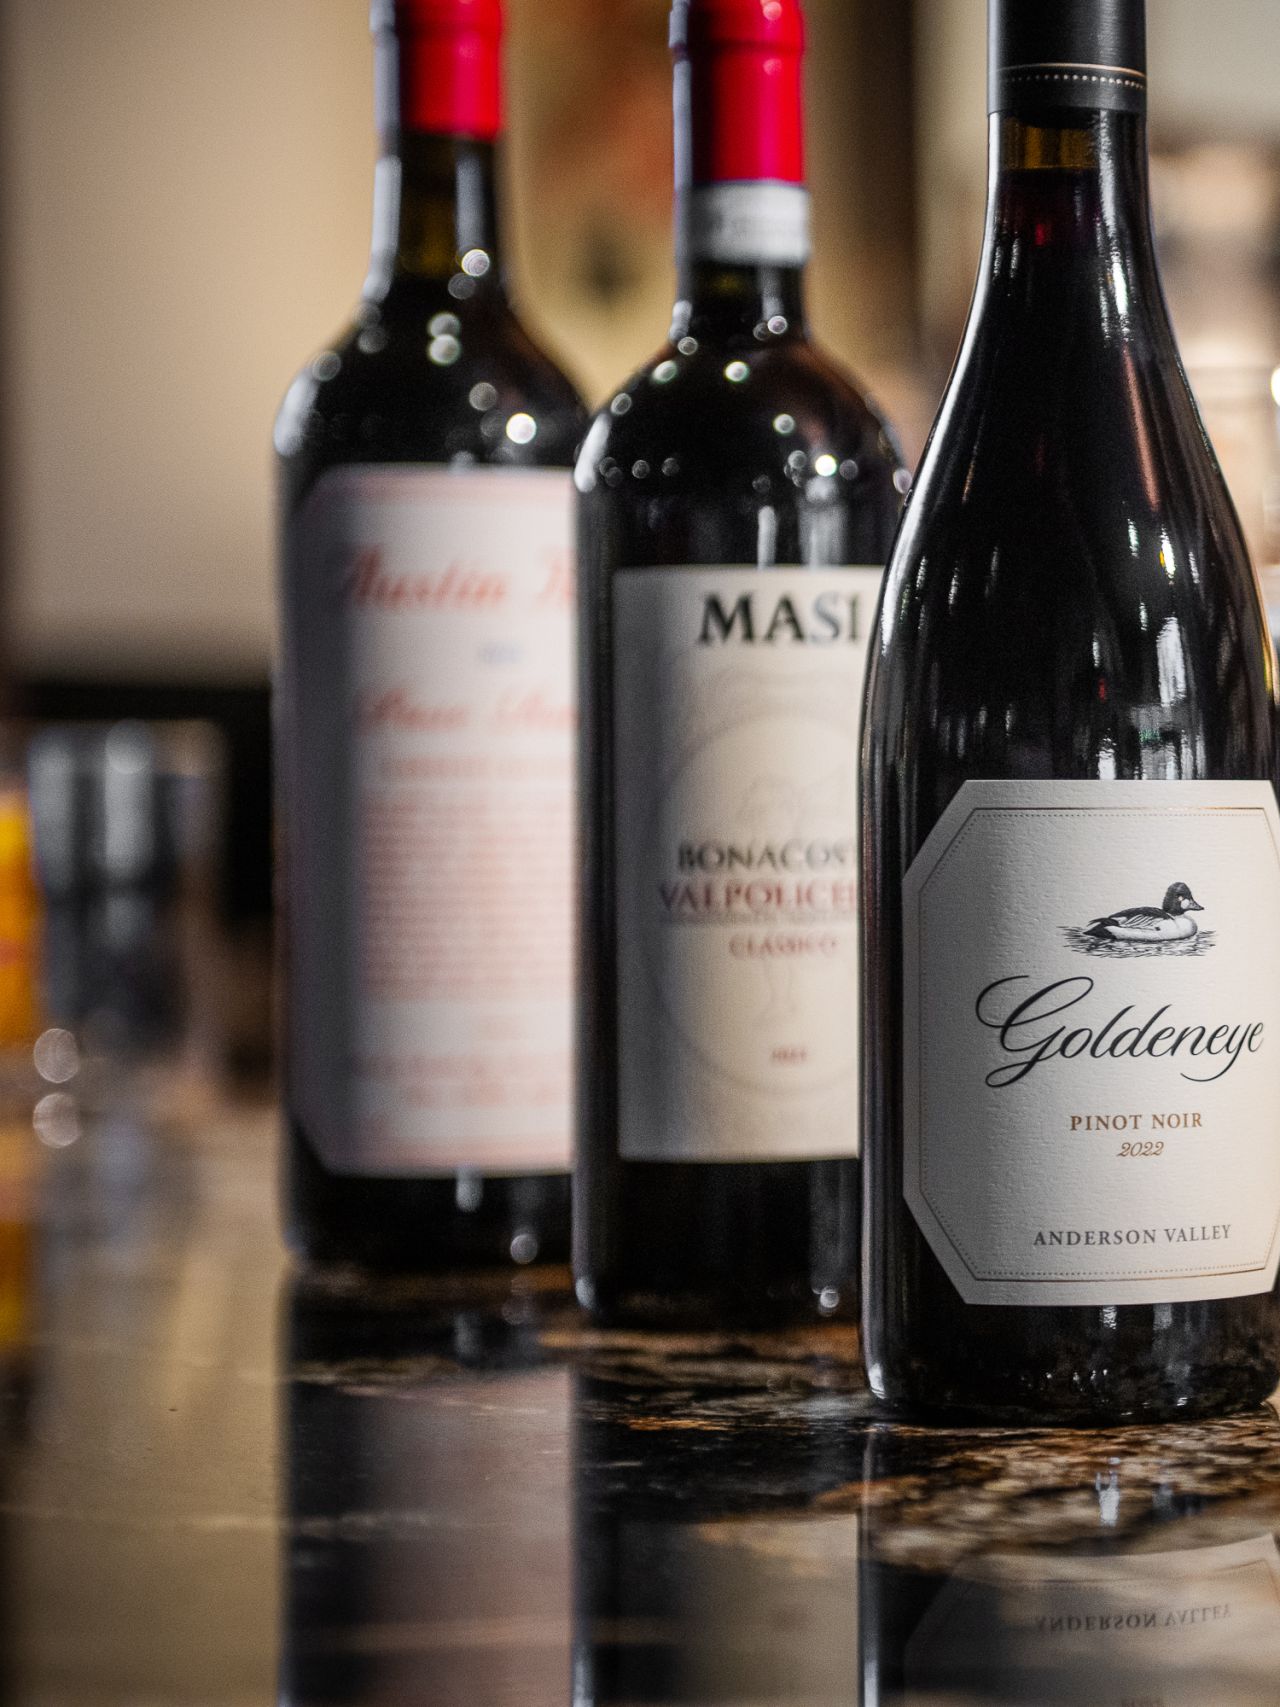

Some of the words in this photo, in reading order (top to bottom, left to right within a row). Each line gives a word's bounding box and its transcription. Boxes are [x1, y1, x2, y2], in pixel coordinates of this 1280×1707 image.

[698, 590, 861, 645] MASI
[677, 841, 856, 872] BONACOS
[975, 974, 1264, 1088] Goldeneye
[1070, 1114, 1142, 1131] PINOT
[1151, 1112, 1203, 1129] NOIR
[1116, 1141, 1165, 1157] 2022
[1033, 1228, 1157, 1247] ANDERSON
[1164, 1224, 1232, 1243] VALLEY
